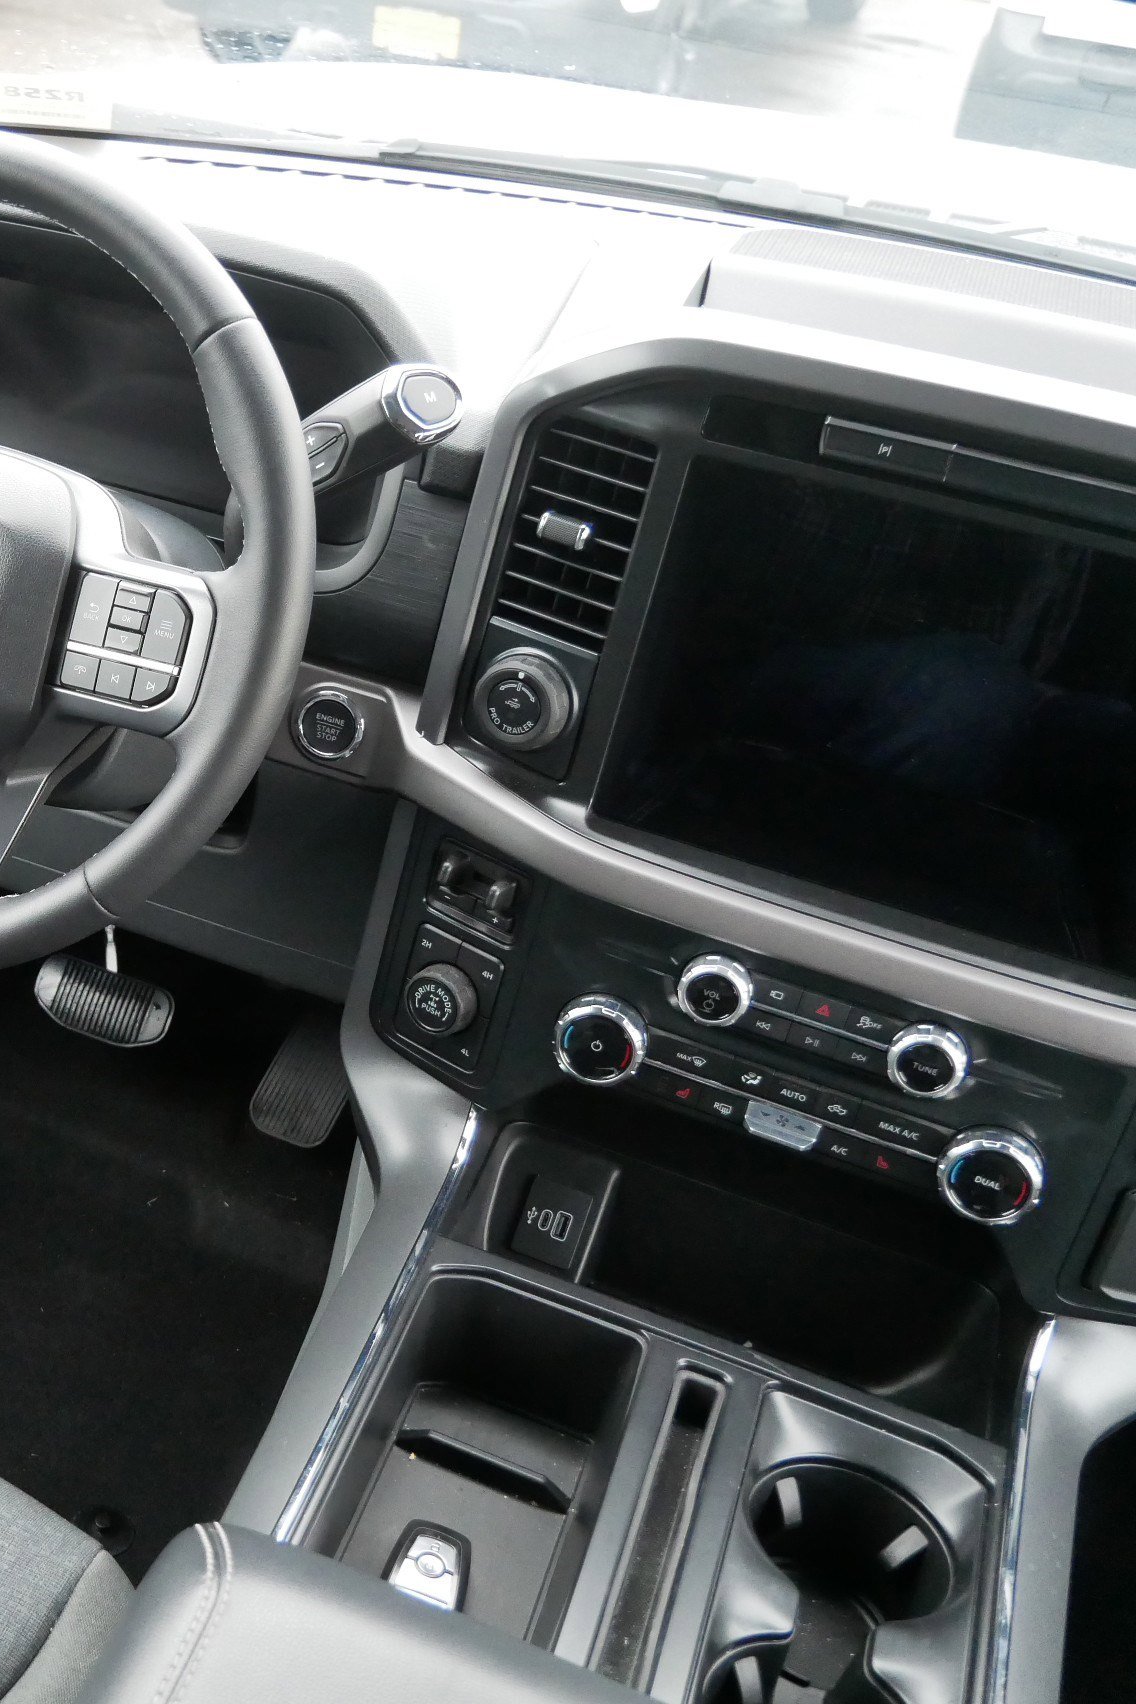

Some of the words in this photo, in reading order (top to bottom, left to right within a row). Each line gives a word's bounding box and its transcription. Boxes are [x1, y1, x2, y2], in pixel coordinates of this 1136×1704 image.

[423, 391, 437, 403] M
[83, 611, 99, 621] BACK
[121, 615, 132, 623] OK
[153, 628, 175, 640] MENU
[315, 712, 345, 727] ENGINE
[488, 706, 501, 726] PRO
[502, 720, 535, 735] TRAILER
[316, 724, 341, 736] START
[316, 731, 337, 742] STOP
[421, 938, 433, 949] 2H
[481, 970, 494, 980] 4H
[414, 984, 436, 999] DRIVE
[436, 987, 452, 1014] MODE
[703, 988, 721, 1001] VOL
[421, 1002, 441, 1017] PUSH
[867, 1021, 883, 1030] OFF
[460, 1047, 470, 1057] 4L
[676, 1052, 692, 1063] MAX
[912, 1061, 939, 1076] TUNE
[780, 1087, 807, 1103] AUTO
[878, 1121, 901, 1135] MAX
[901, 1128, 920, 1141] A/C
[830, 1144, 849, 1156] A/C
[974, 1175, 1001, 1190] DUAL
